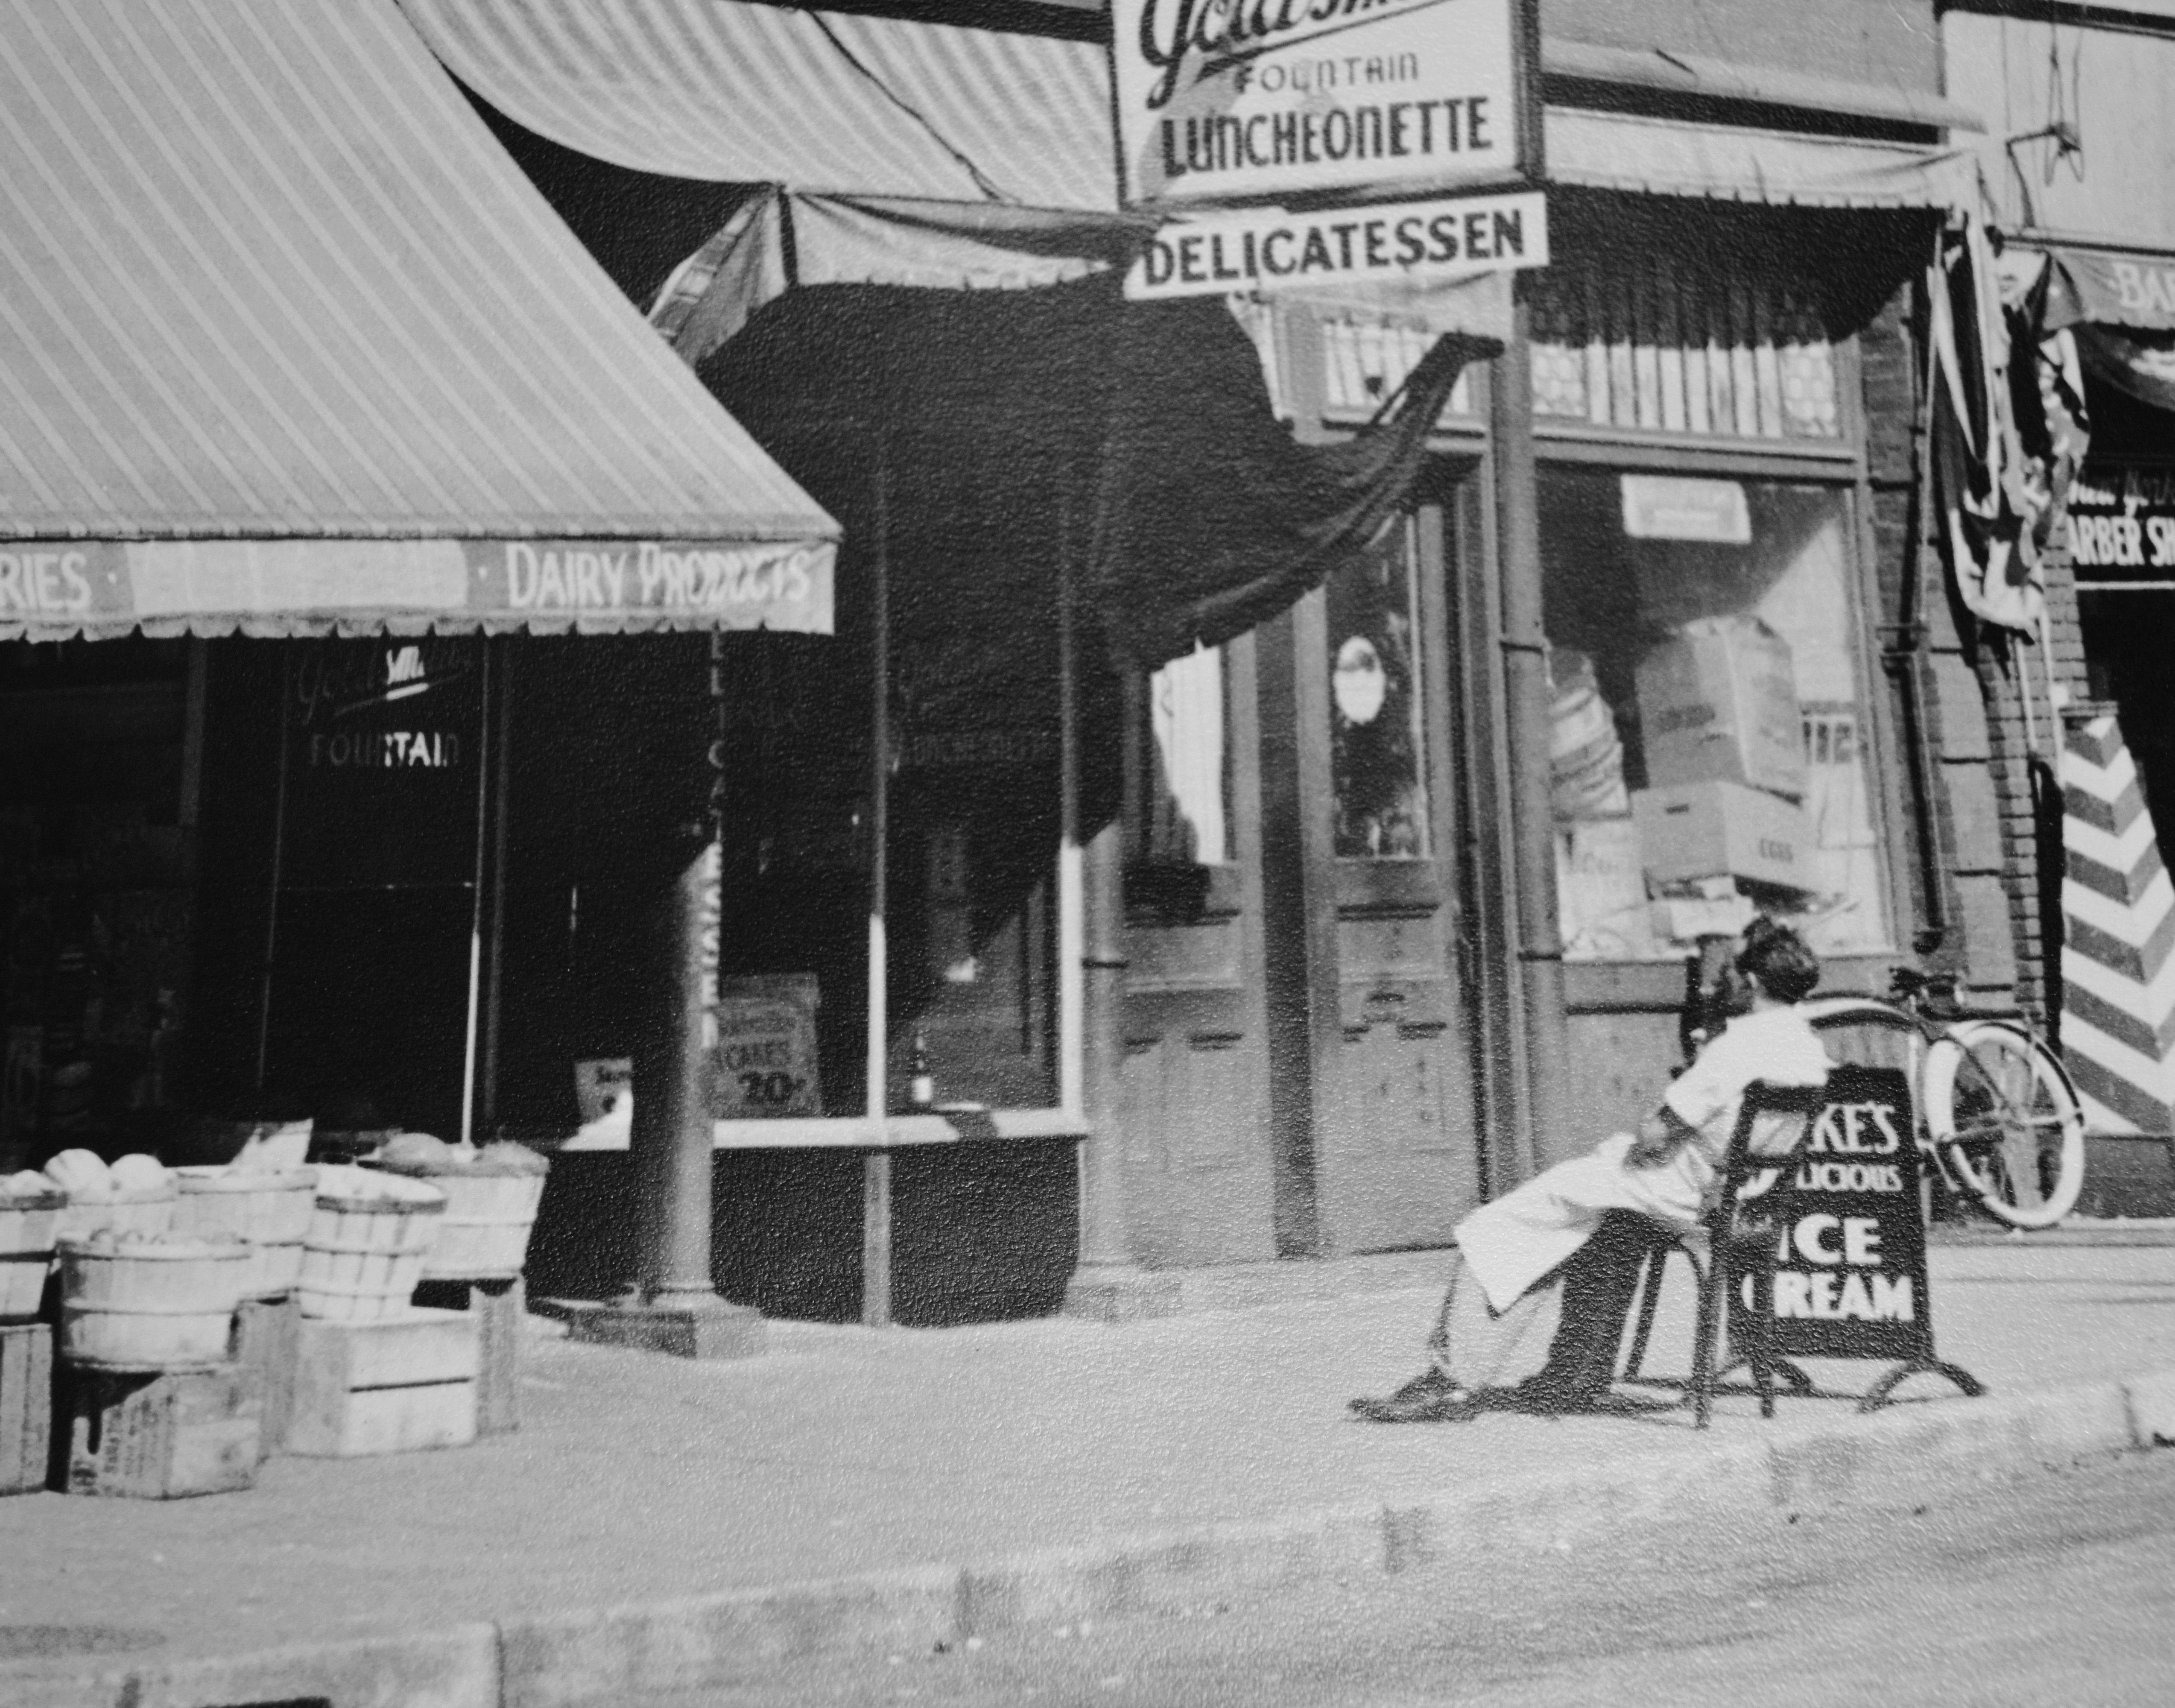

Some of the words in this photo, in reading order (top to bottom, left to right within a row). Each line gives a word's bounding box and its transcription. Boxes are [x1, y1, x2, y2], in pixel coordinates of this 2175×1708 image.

[1234, 52, 1419, 94] FOUNTAIN
[1161, 96, 1492, 177] LUNCHEONETTE
[1145, 209, 1524, 286] DELICATESSEN
[506, 542, 629, 608] DAIRY
